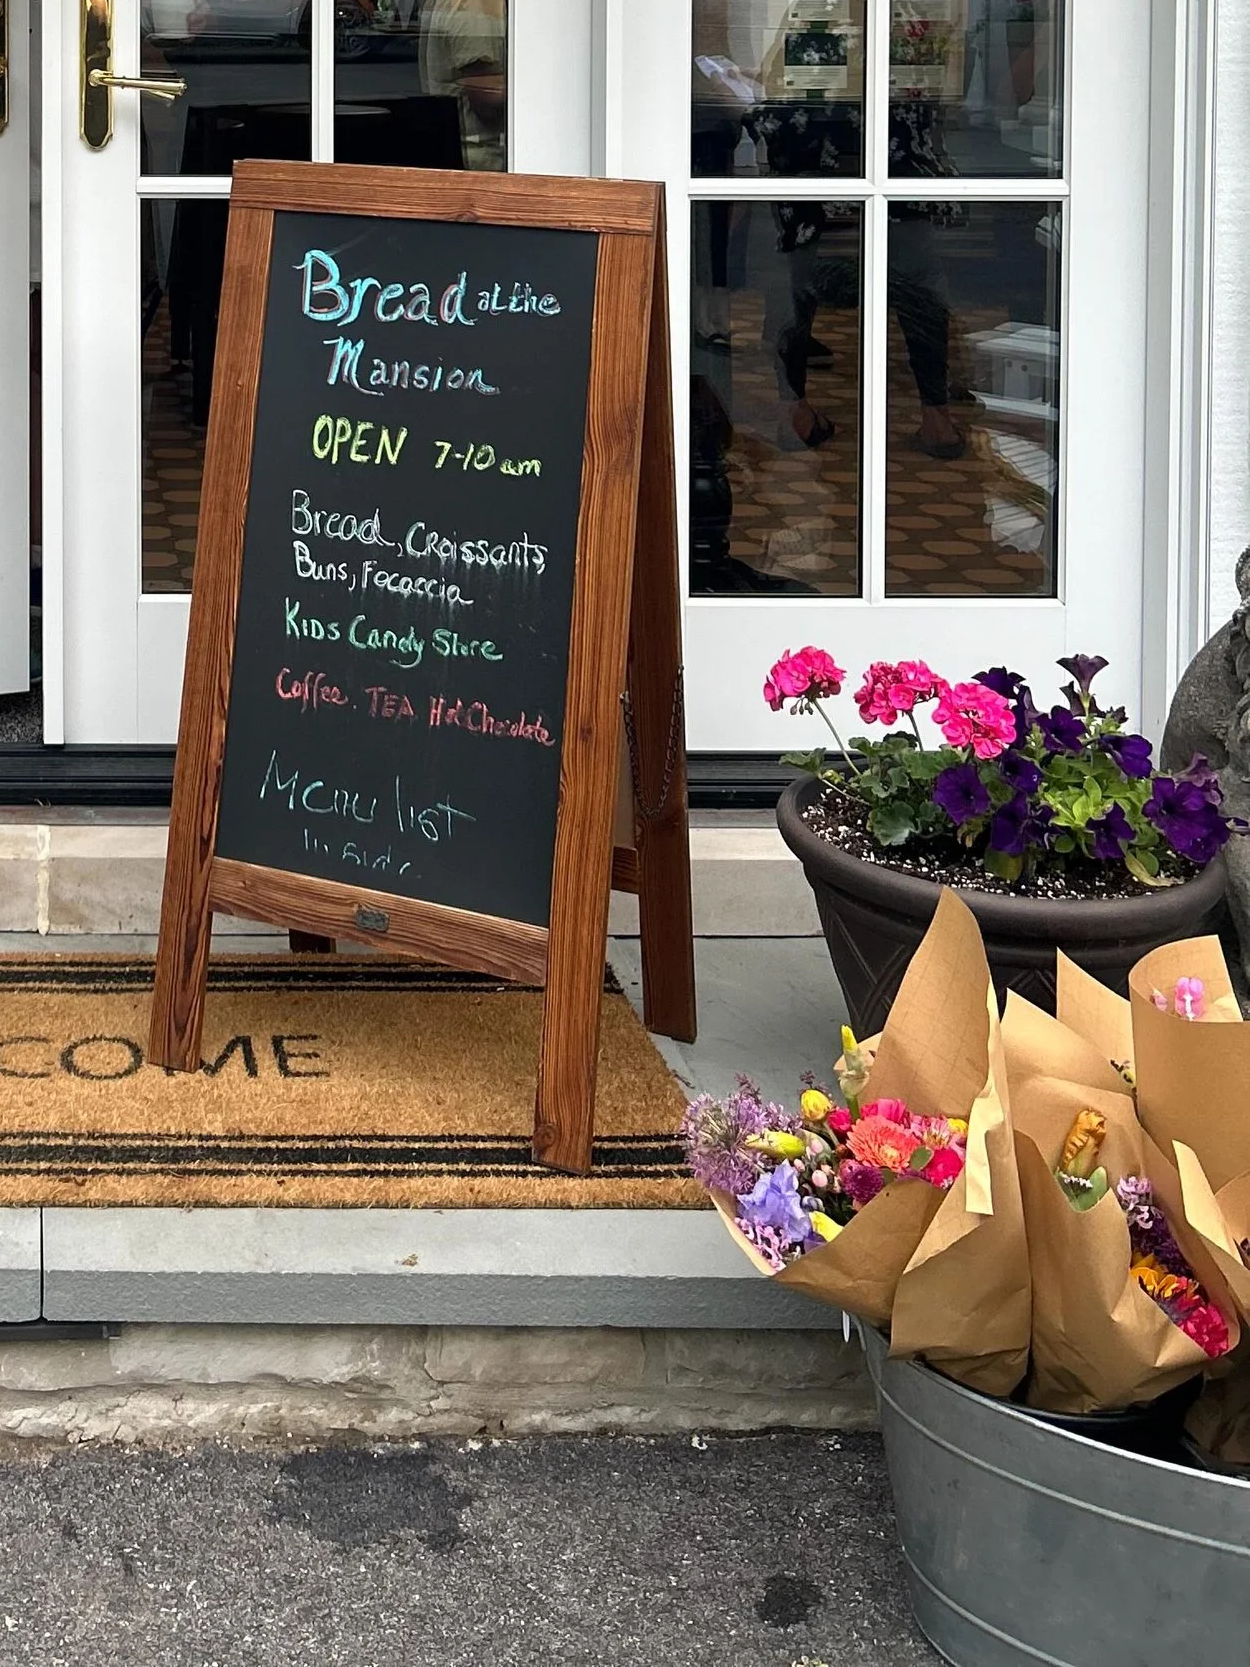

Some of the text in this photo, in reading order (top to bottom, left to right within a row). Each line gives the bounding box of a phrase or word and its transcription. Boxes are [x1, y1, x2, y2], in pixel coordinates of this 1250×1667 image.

[292, 248, 478, 327] Bread
[323, 335, 502, 397] Mansion
[312, 413, 543, 478] OPEN 7-10 am
[293, 540, 475, 606] Buns, Focaccia
[349, 614, 427, 668] Candy
[432, 628, 504, 662] Store
[364, 686, 417, 721] TEA
